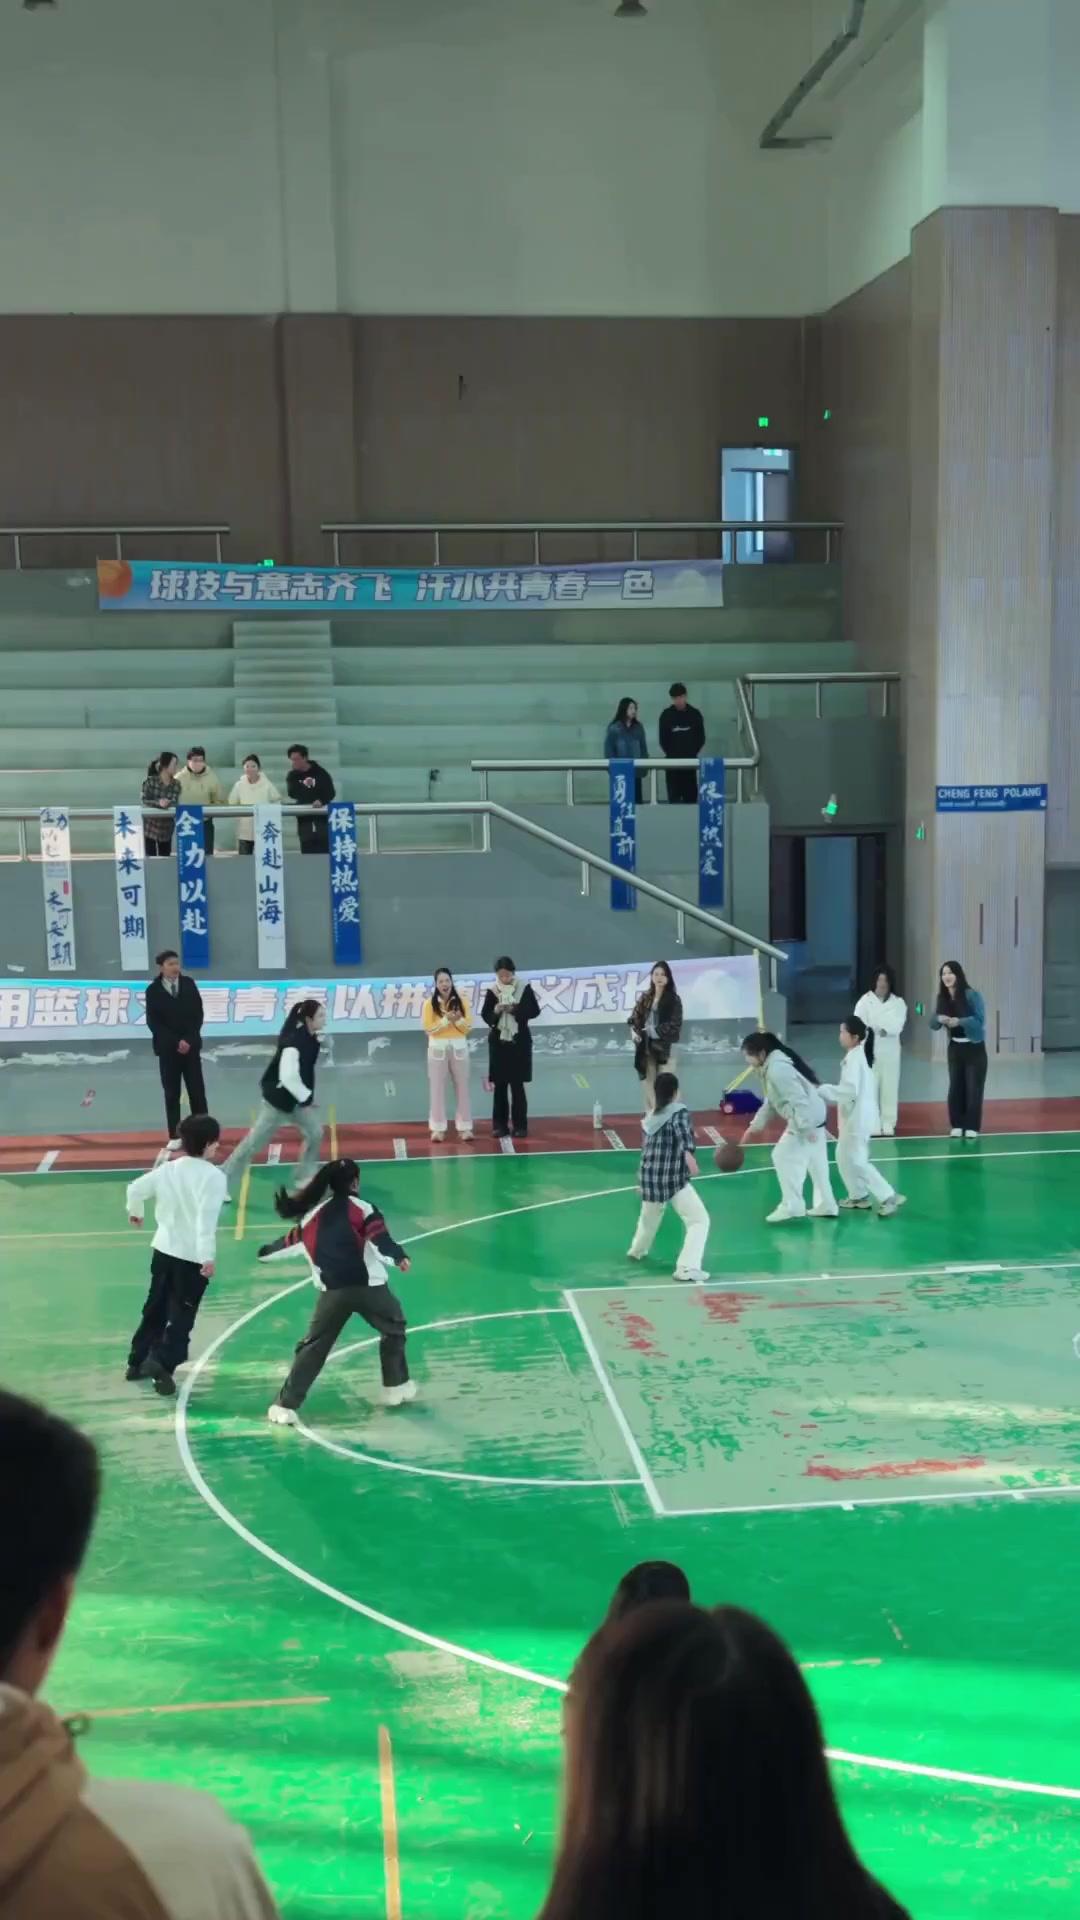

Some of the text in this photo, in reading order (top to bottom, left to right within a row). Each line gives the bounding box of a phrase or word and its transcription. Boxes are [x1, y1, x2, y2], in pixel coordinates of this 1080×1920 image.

[150, 569, 654, 601] 球技与意志齐飞 汗水共青春一色
[938, 787, 1041, 799] CHENG FENG POLANG
[115, 811, 145, 939] 未来可期
[176, 810, 208, 935] 全力以赴
[258, 820, 283, 925] 奔赴山海
[328, 807, 360, 923] 保持热爱
